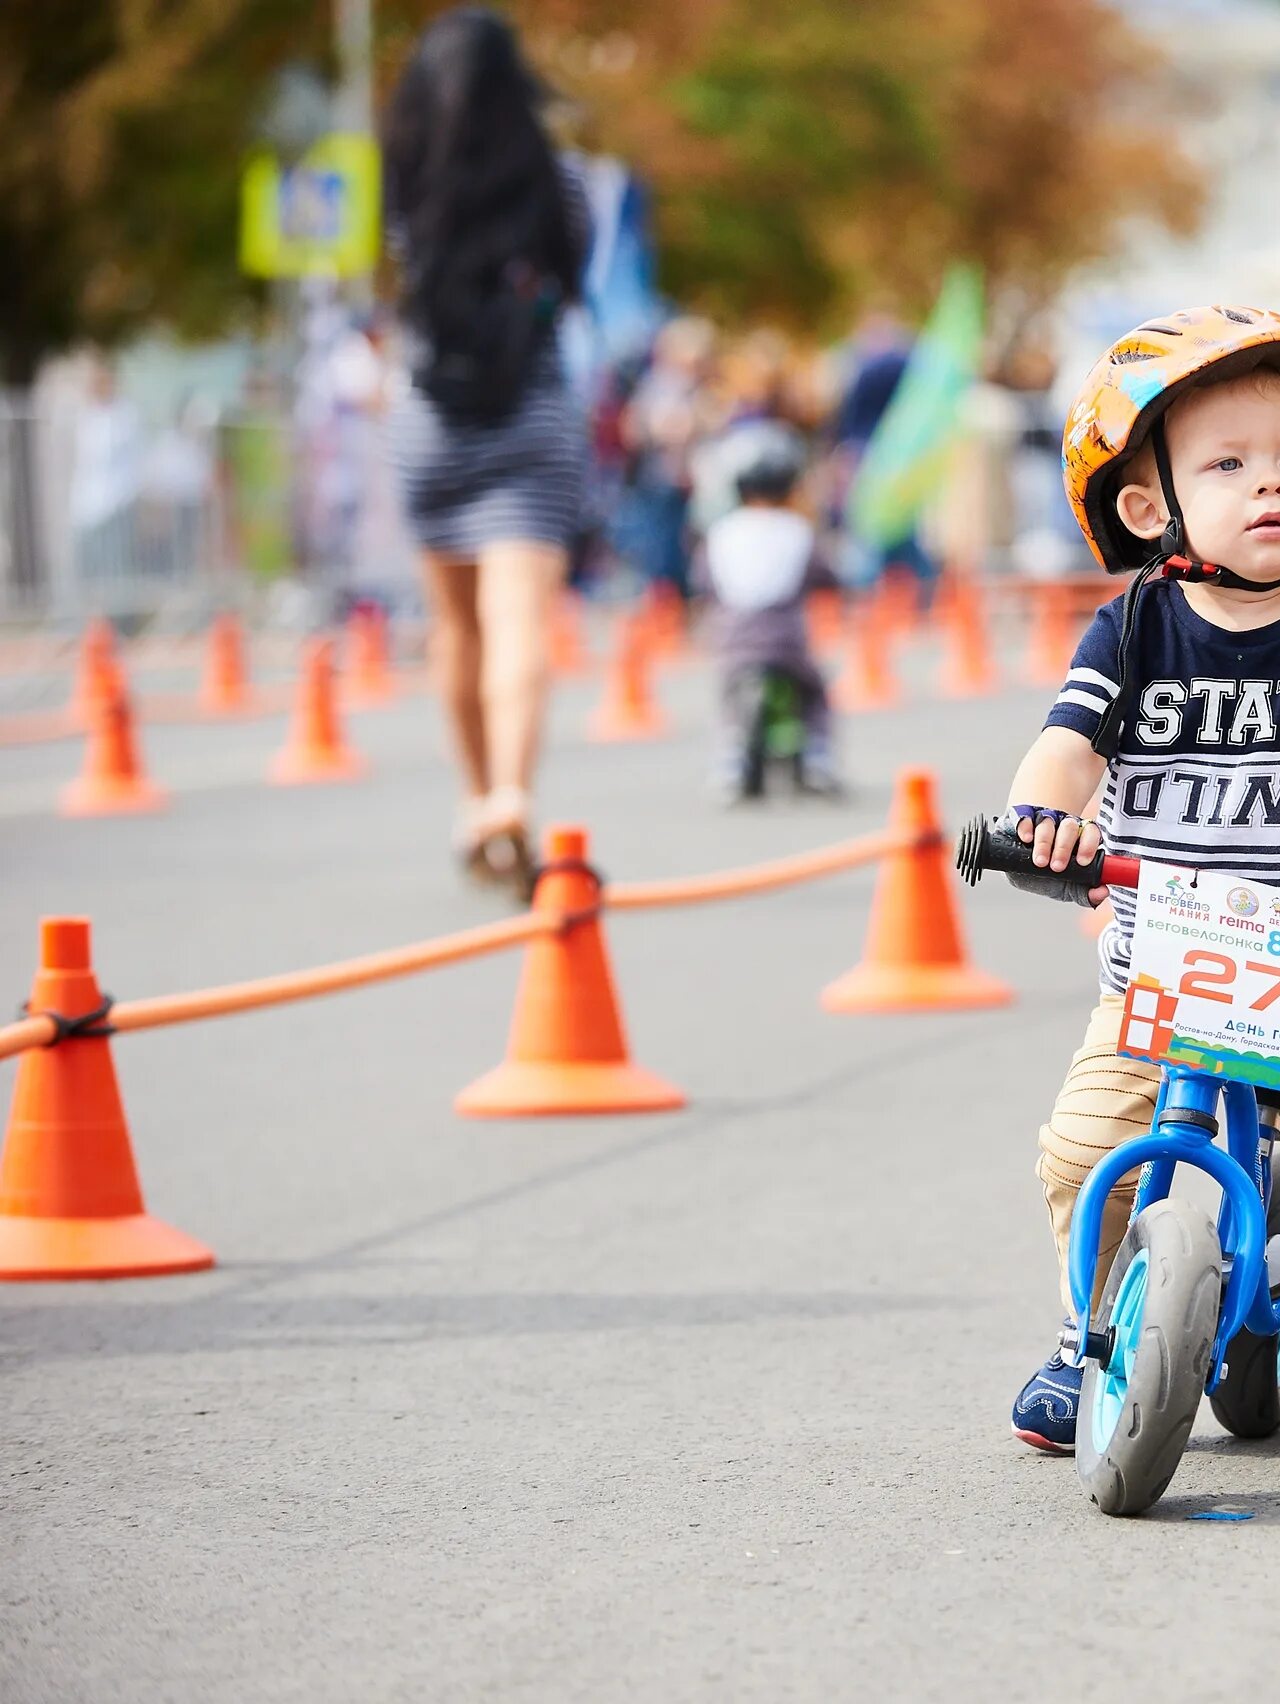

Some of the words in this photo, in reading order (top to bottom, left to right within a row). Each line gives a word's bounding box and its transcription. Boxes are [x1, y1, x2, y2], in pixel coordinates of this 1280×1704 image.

[1169, 907, 1210, 922] МАНИЯ
[1219, 915, 1265, 933] reima
[1240, 1036, 1280, 1052] Городская
